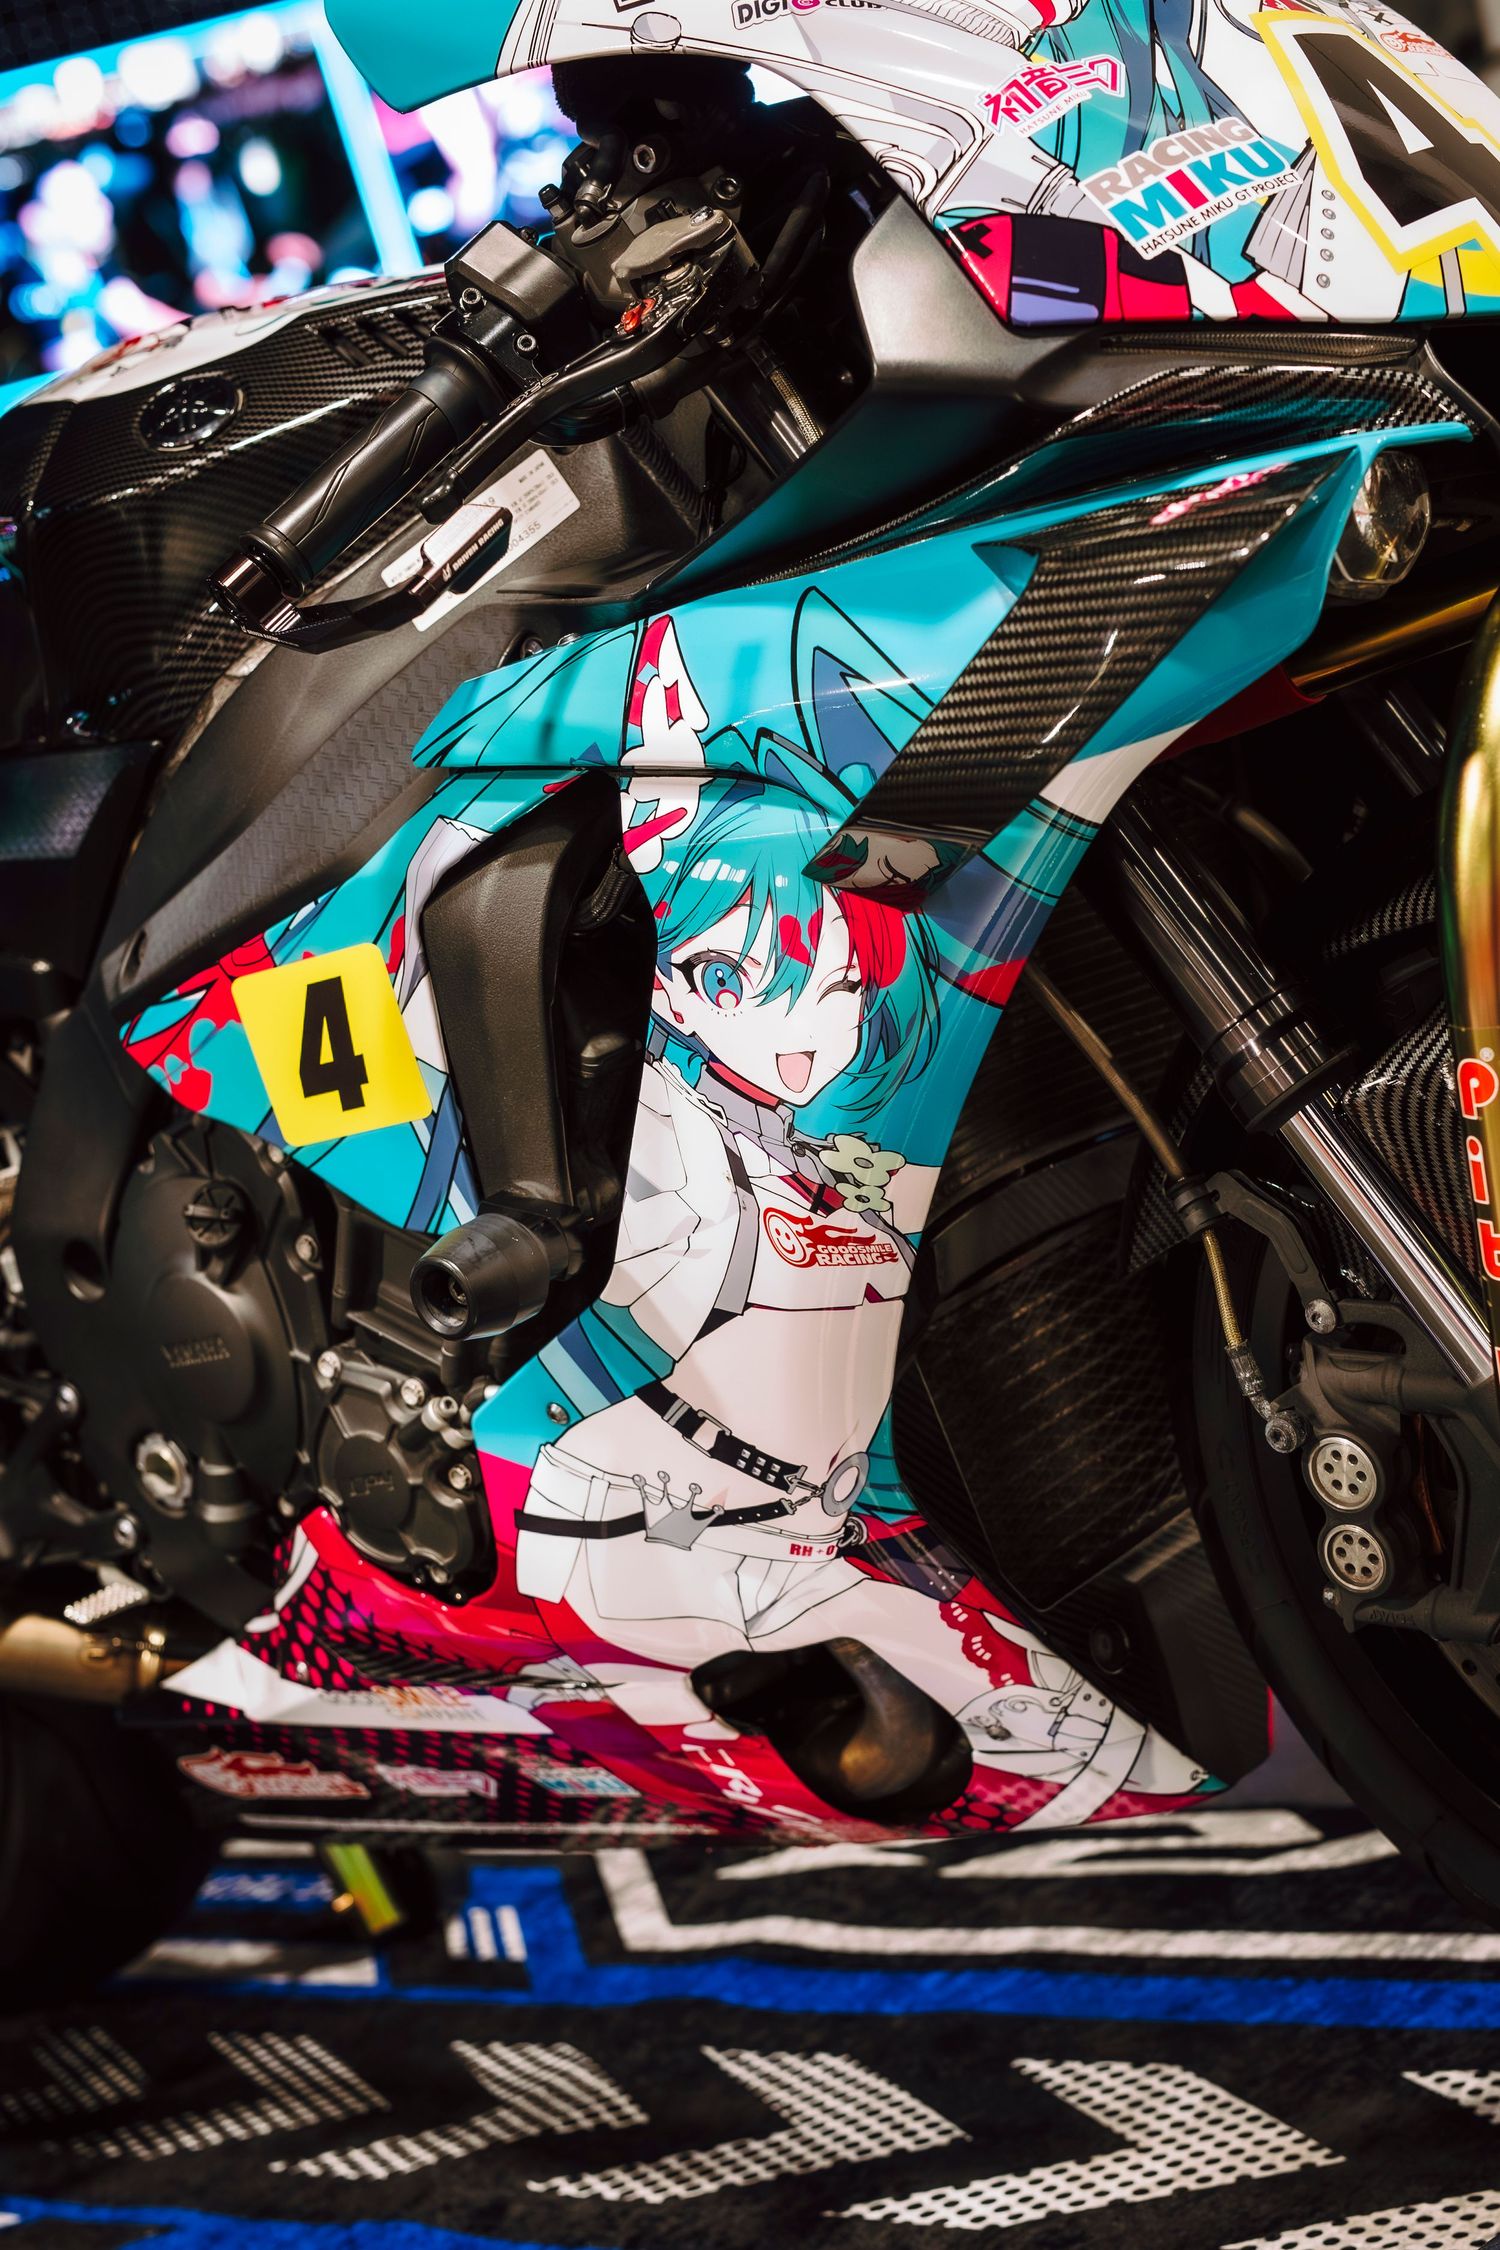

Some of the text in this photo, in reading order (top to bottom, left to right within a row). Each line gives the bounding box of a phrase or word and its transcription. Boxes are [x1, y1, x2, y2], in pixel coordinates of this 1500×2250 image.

[984, 58, 1117, 126] 初音ミク
[1019, 90, 1088, 134] HATSUNE MIKU
[1086, 119, 1255, 204] RACING
[1108, 140, 1286, 242] MIKU
[1141, 172, 1299, 254] HATSUNE MIKU GT PROJECT
[452, 542, 479, 571] DRIVEN
[478, 518, 504, 546] RACING
[299, 975, 369, 1112] 4
[815, 1253, 882, 1266] RACING
[816, 1243, 893, 1253] GOODSMILE
[790, 1544, 813, 1556] RH
